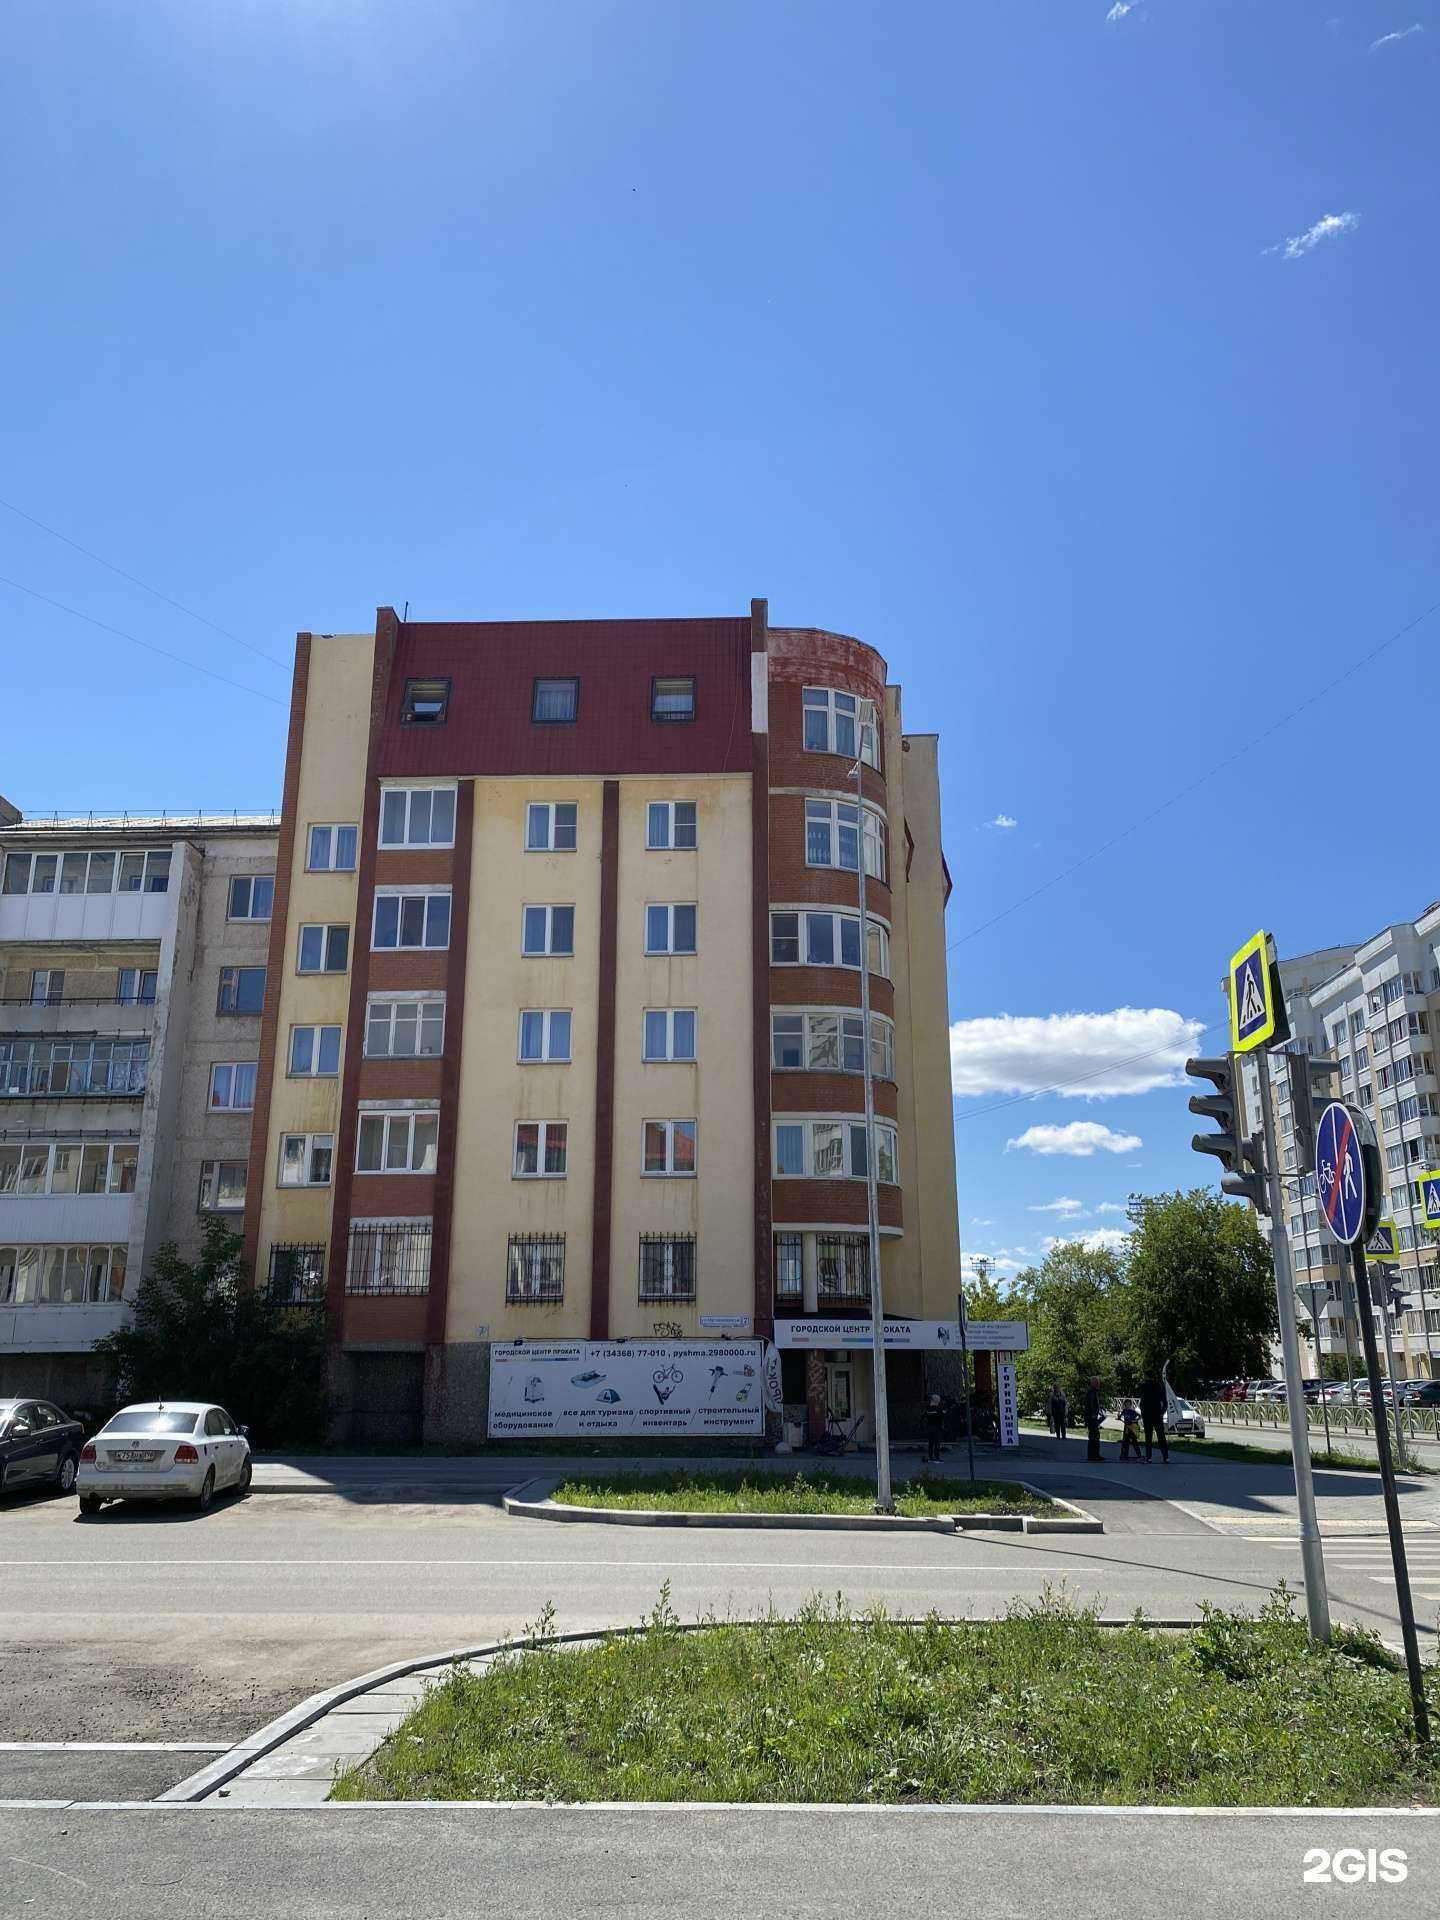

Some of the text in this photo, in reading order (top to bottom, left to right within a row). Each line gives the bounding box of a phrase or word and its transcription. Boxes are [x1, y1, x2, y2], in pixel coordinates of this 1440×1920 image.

[791, 1325, 911, 1335] ГОРОДСКОЙ ЦЕНТР ОКАТА
[494, 1349, 530, 1357] ГОРОДСКОЙ
[603, 1349, 635, 1358] (34368)
[673, 1349, 756, 1358] pyshma.2980000.ru
[1003, 1366, 1014, 1444] ГОРНОЛЫЖКА
[598, 1409, 634, 1417] туризма
[639, 1408, 691, 1416] спортивный
[698, 1407, 760, 1415] строительный
[493, 1421, 554, 1430] оборудование
